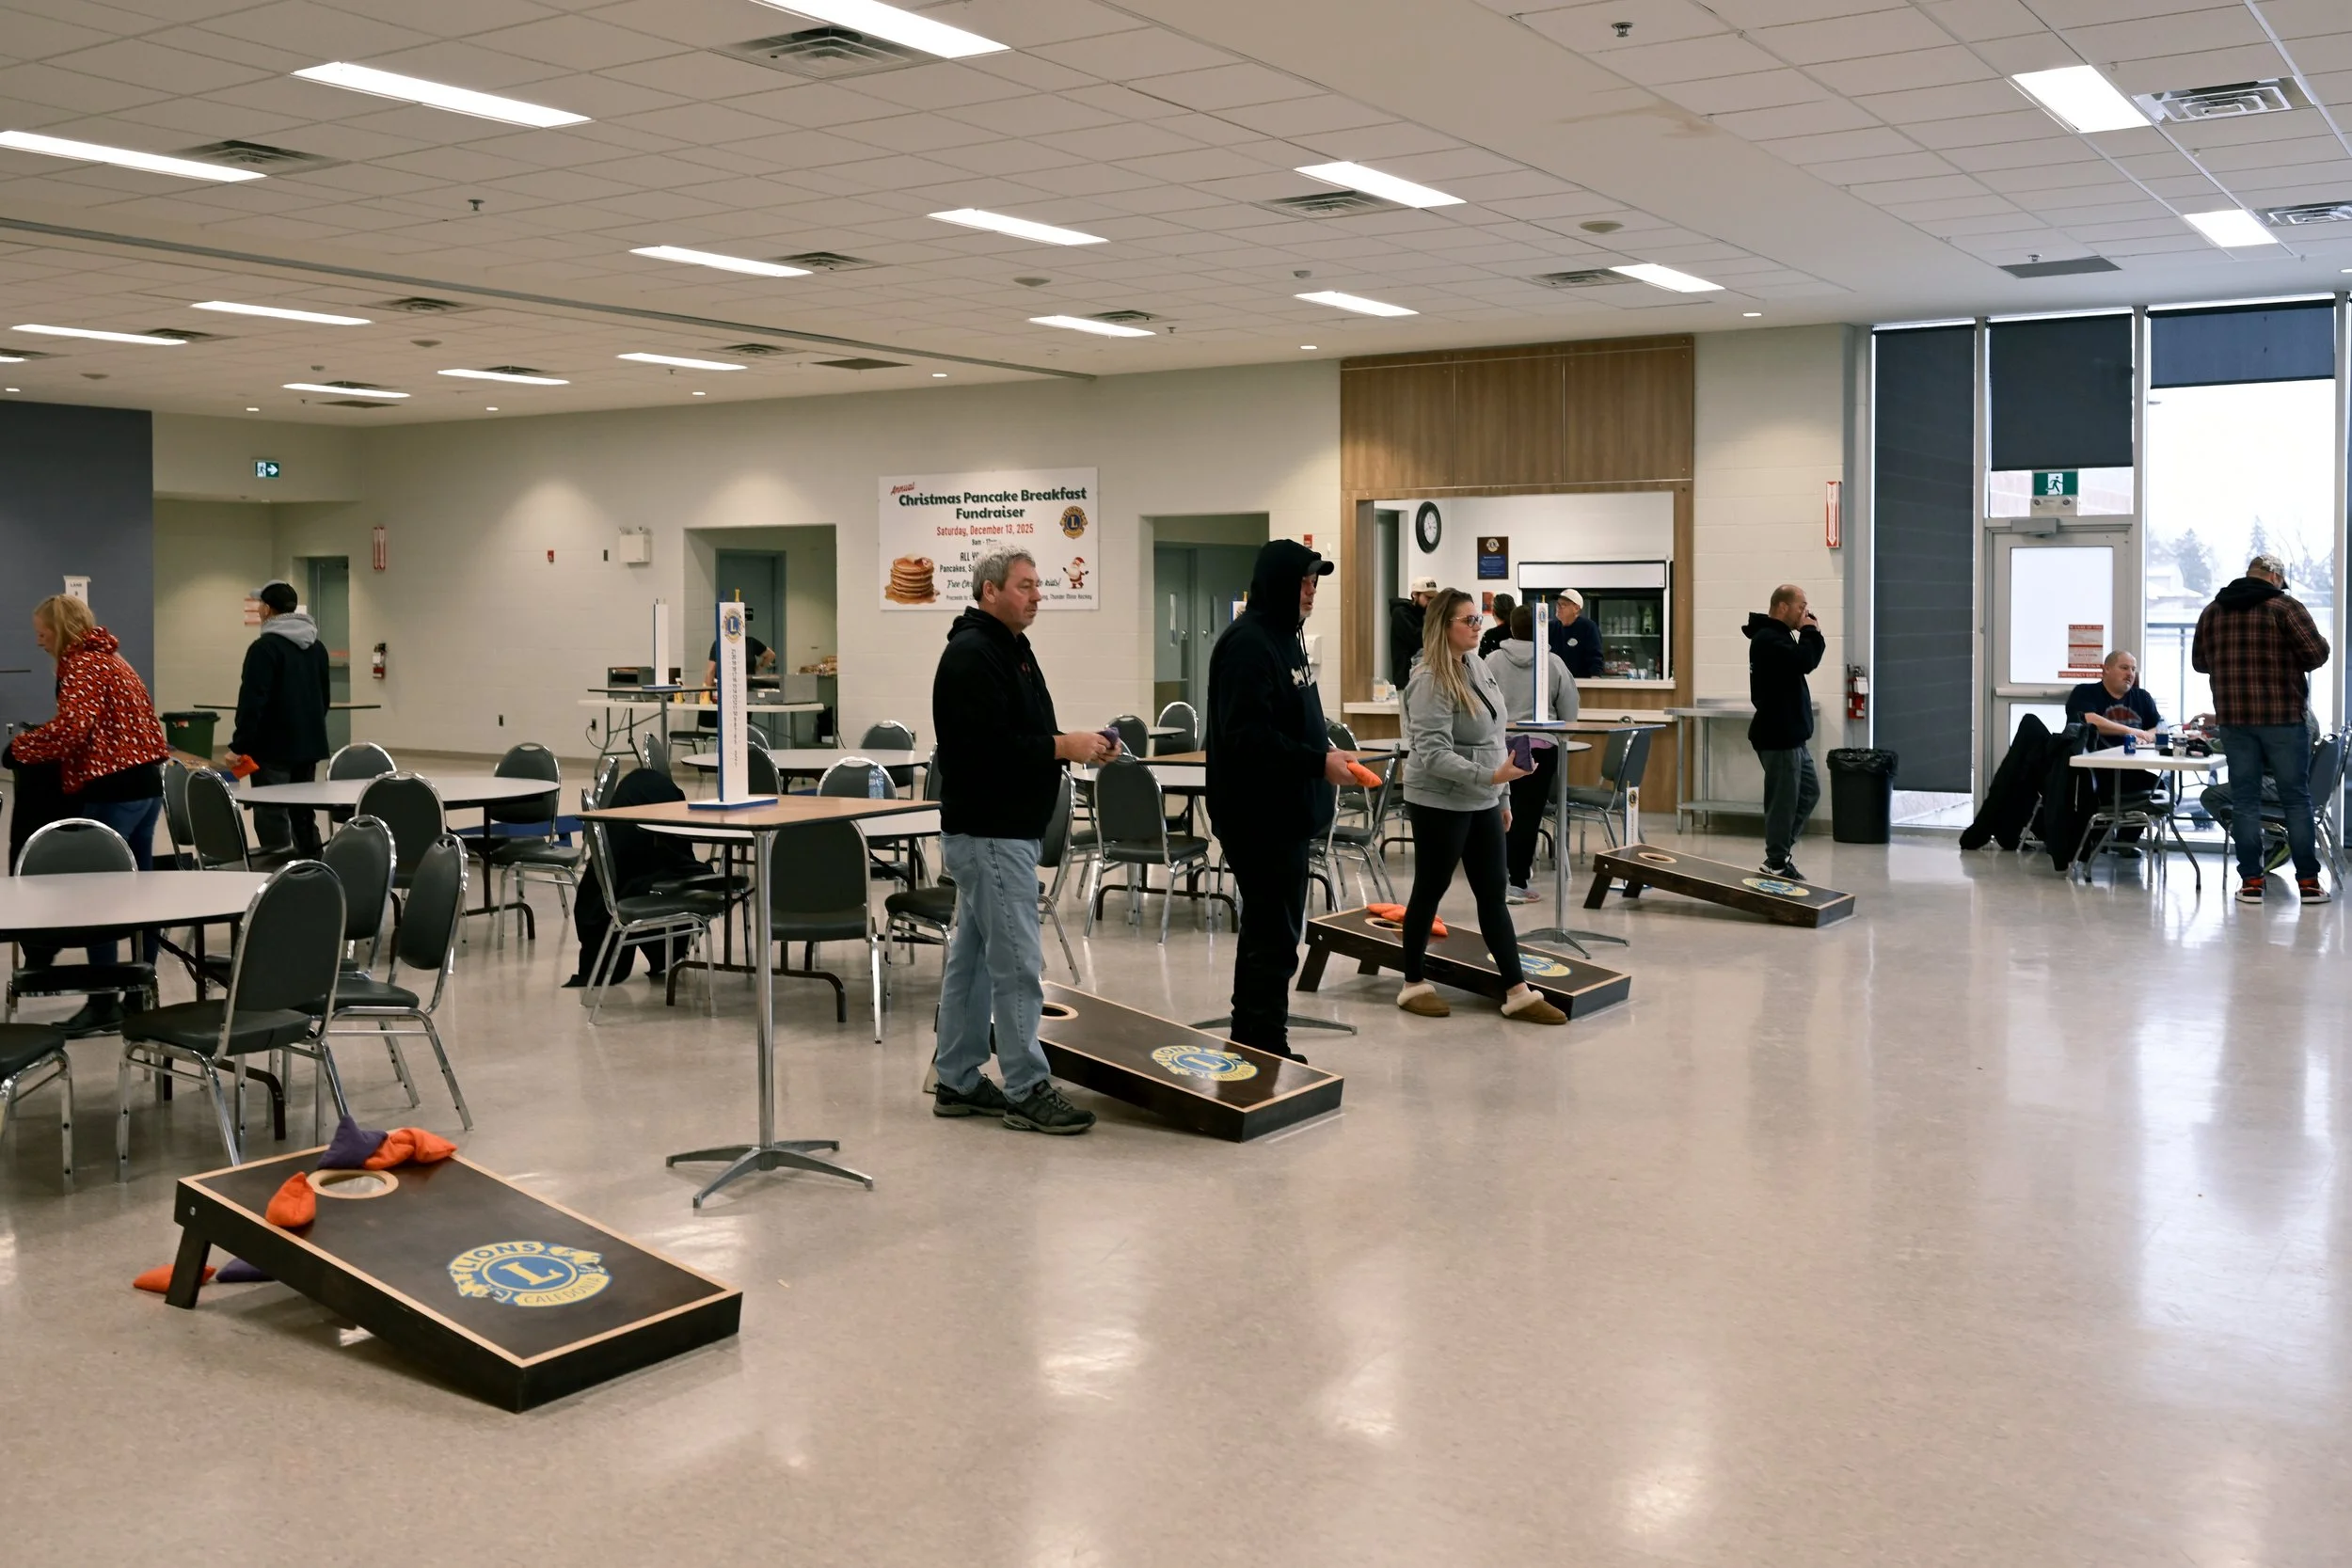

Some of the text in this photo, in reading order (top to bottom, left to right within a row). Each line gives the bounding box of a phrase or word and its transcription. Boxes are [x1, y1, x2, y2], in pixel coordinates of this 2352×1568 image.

[890, 482, 915, 496] Annual
[898, 486, 1088, 507] Christmas Pancake Breakfast
[956, 505, 1025, 520] Fundraiser
[936, 523, 1034, 537] Saturday, December 13, 2025
[960, 551, 970, 562] ALL
[939, 564, 967, 574] Pancakes,
[730, 618, 738, 632] L
[1184, 1056, 1227, 1070] L
[455, 1243, 537, 1269] LIONS
[499, 1261, 564, 1286] L
